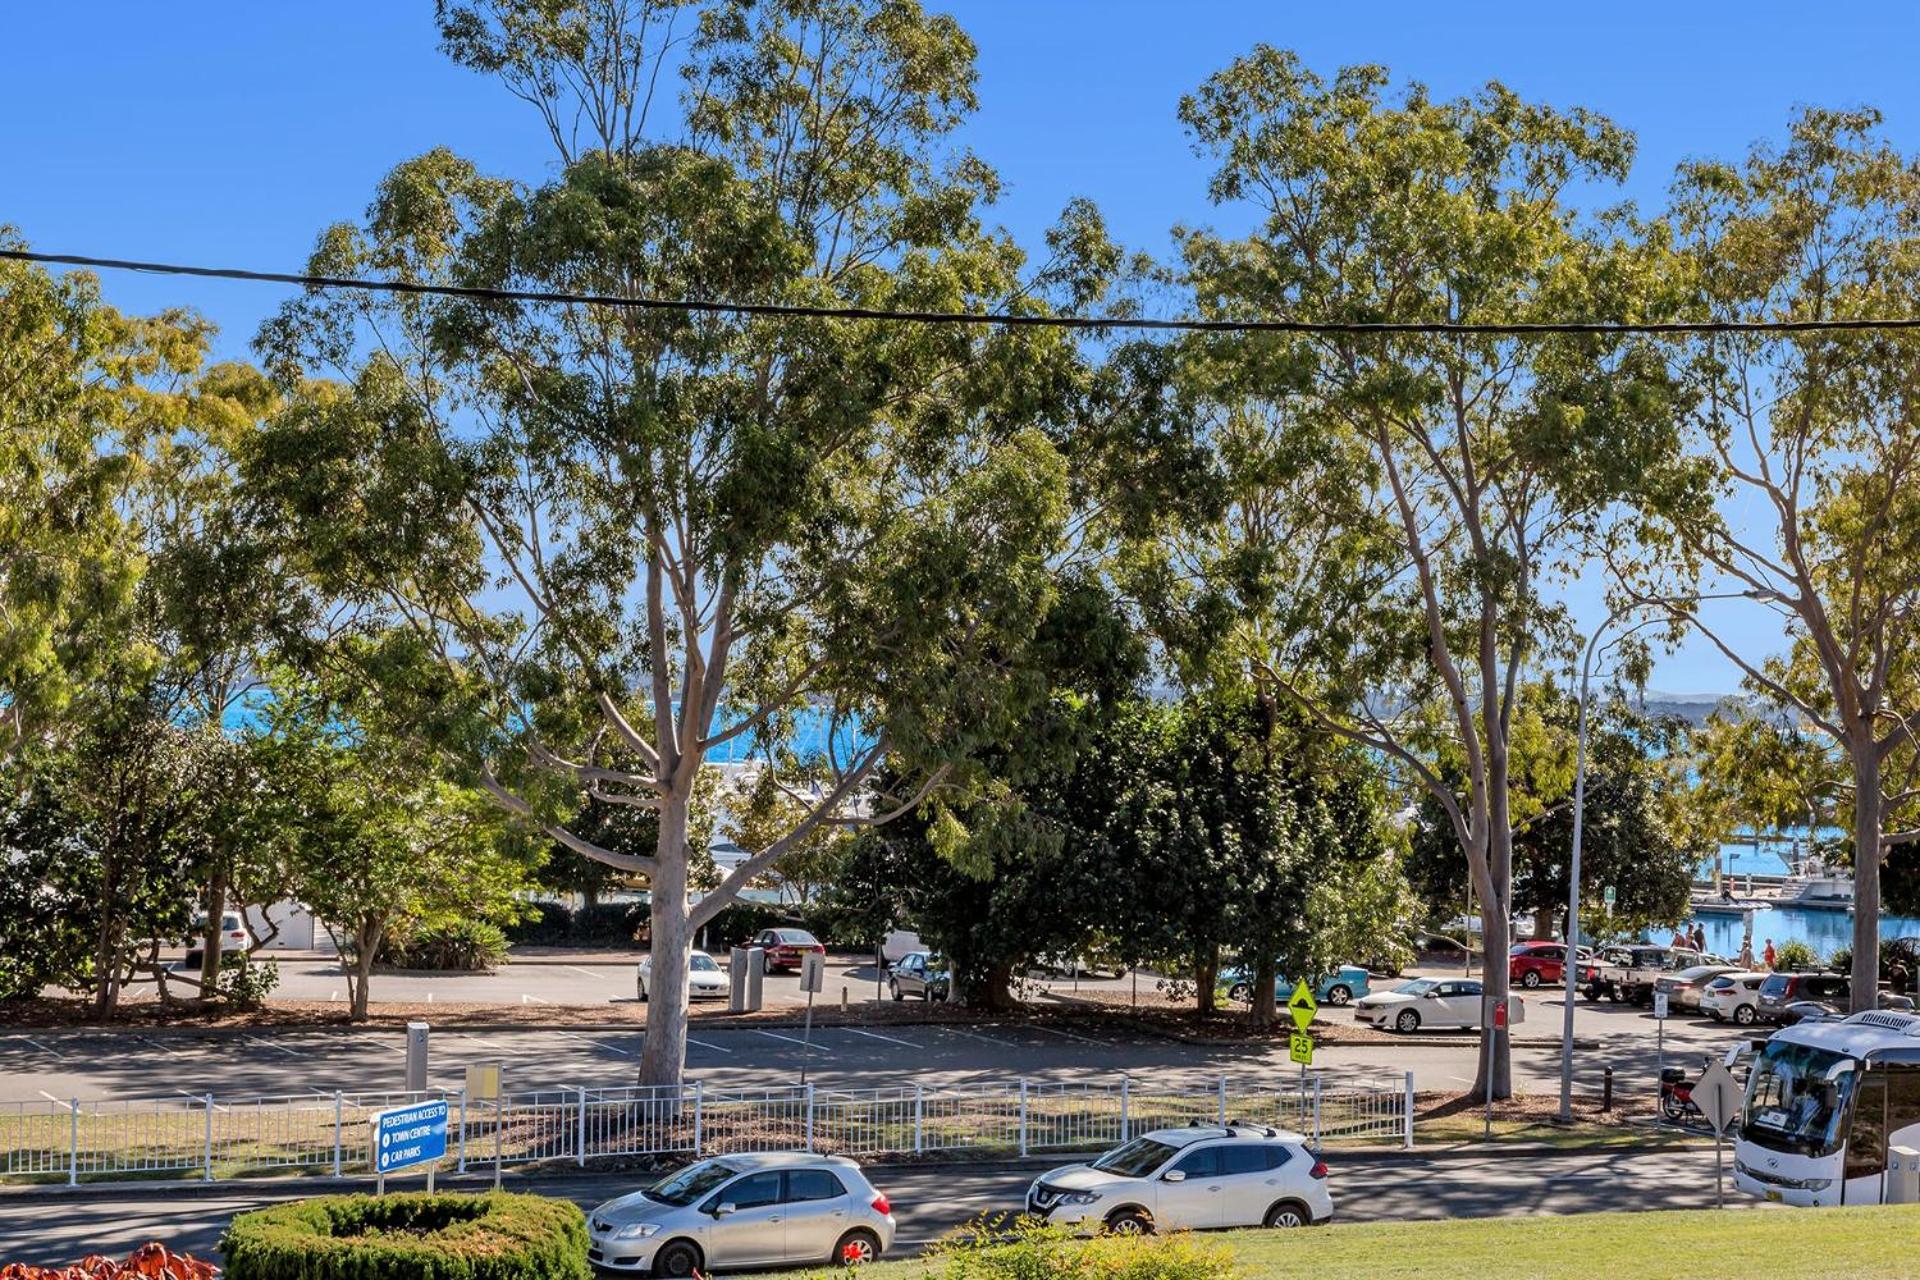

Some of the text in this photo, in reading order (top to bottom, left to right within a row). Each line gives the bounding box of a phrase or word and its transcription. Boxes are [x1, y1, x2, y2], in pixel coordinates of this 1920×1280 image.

[1295, 1038, 1308, 1053] 25
[383, 1105, 446, 1128] PEDESTRIAN ACCESS TO
[392, 1125, 431, 1143] TOWN CENTRE
[391, 1146, 421, 1162] CAR PARKS
